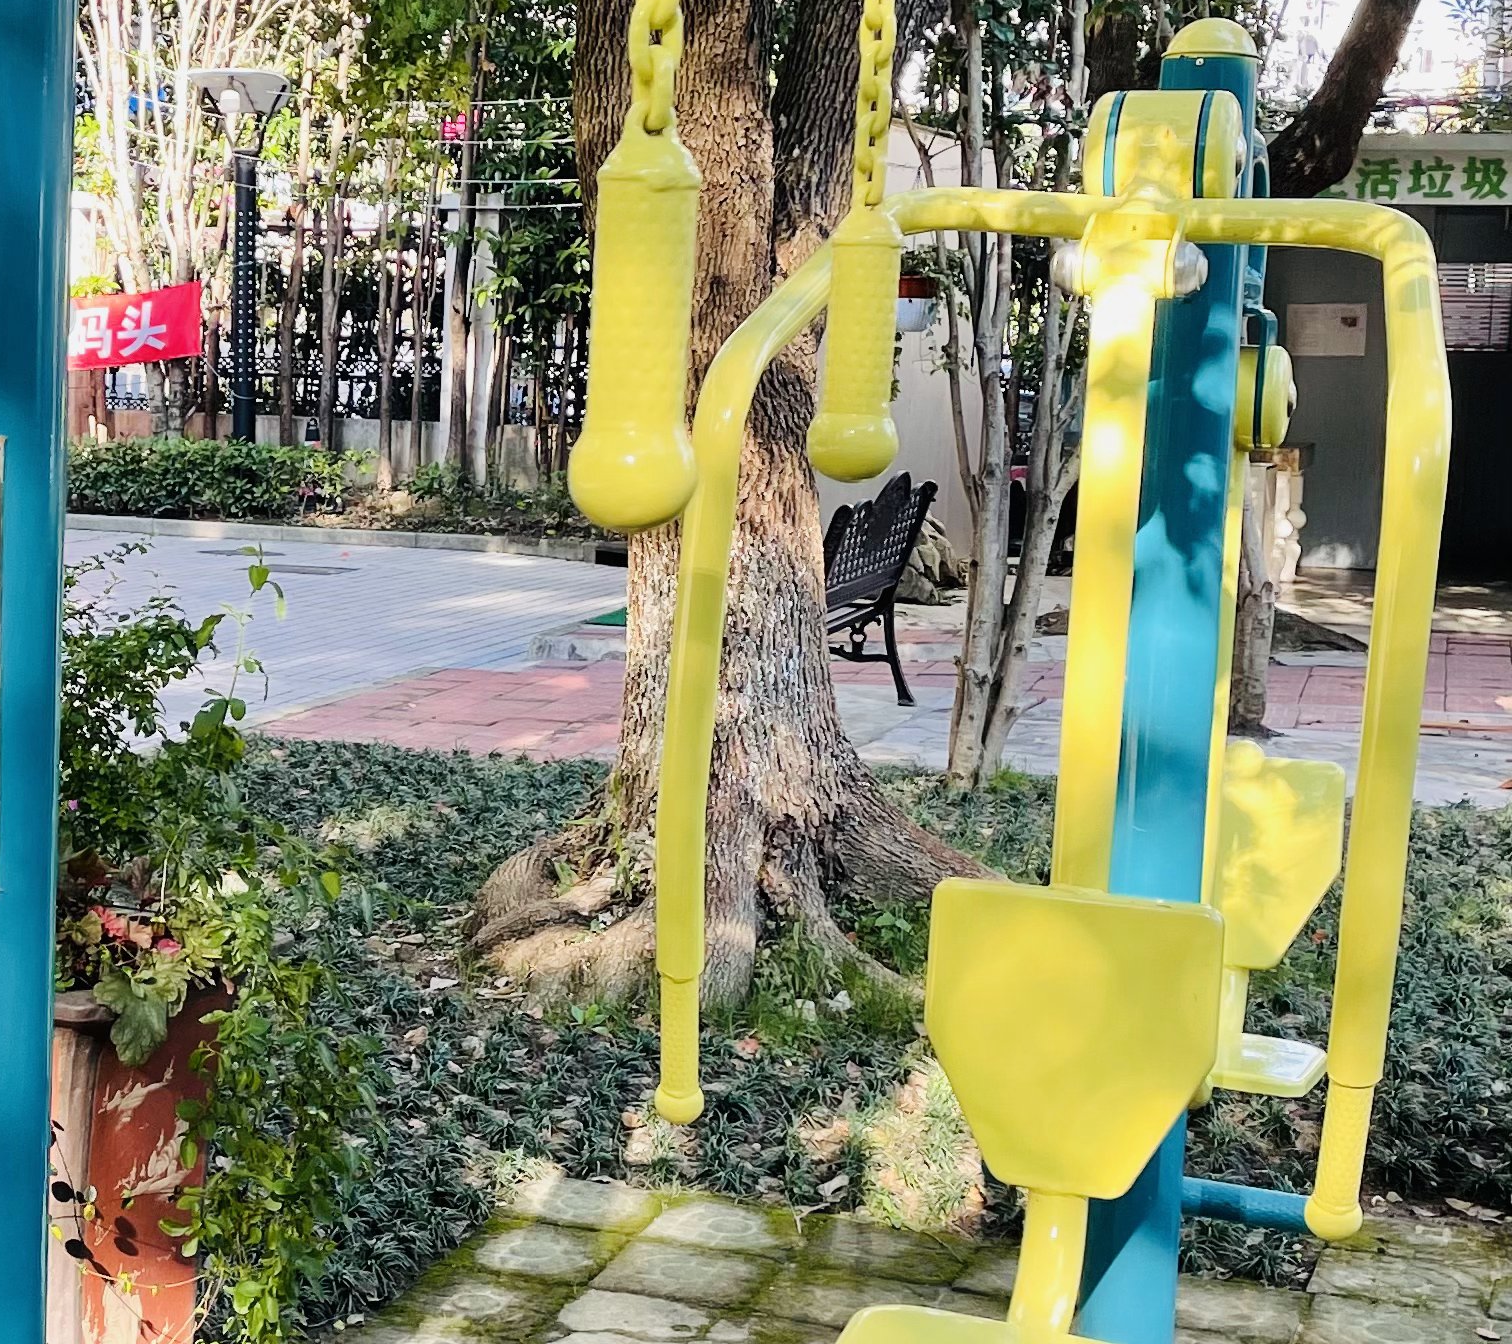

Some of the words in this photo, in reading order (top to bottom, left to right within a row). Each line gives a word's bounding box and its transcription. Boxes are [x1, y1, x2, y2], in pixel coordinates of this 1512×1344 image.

[1318, 156, 1508, 201] 活垃圾
[68, 301, 167, 359] 码头
